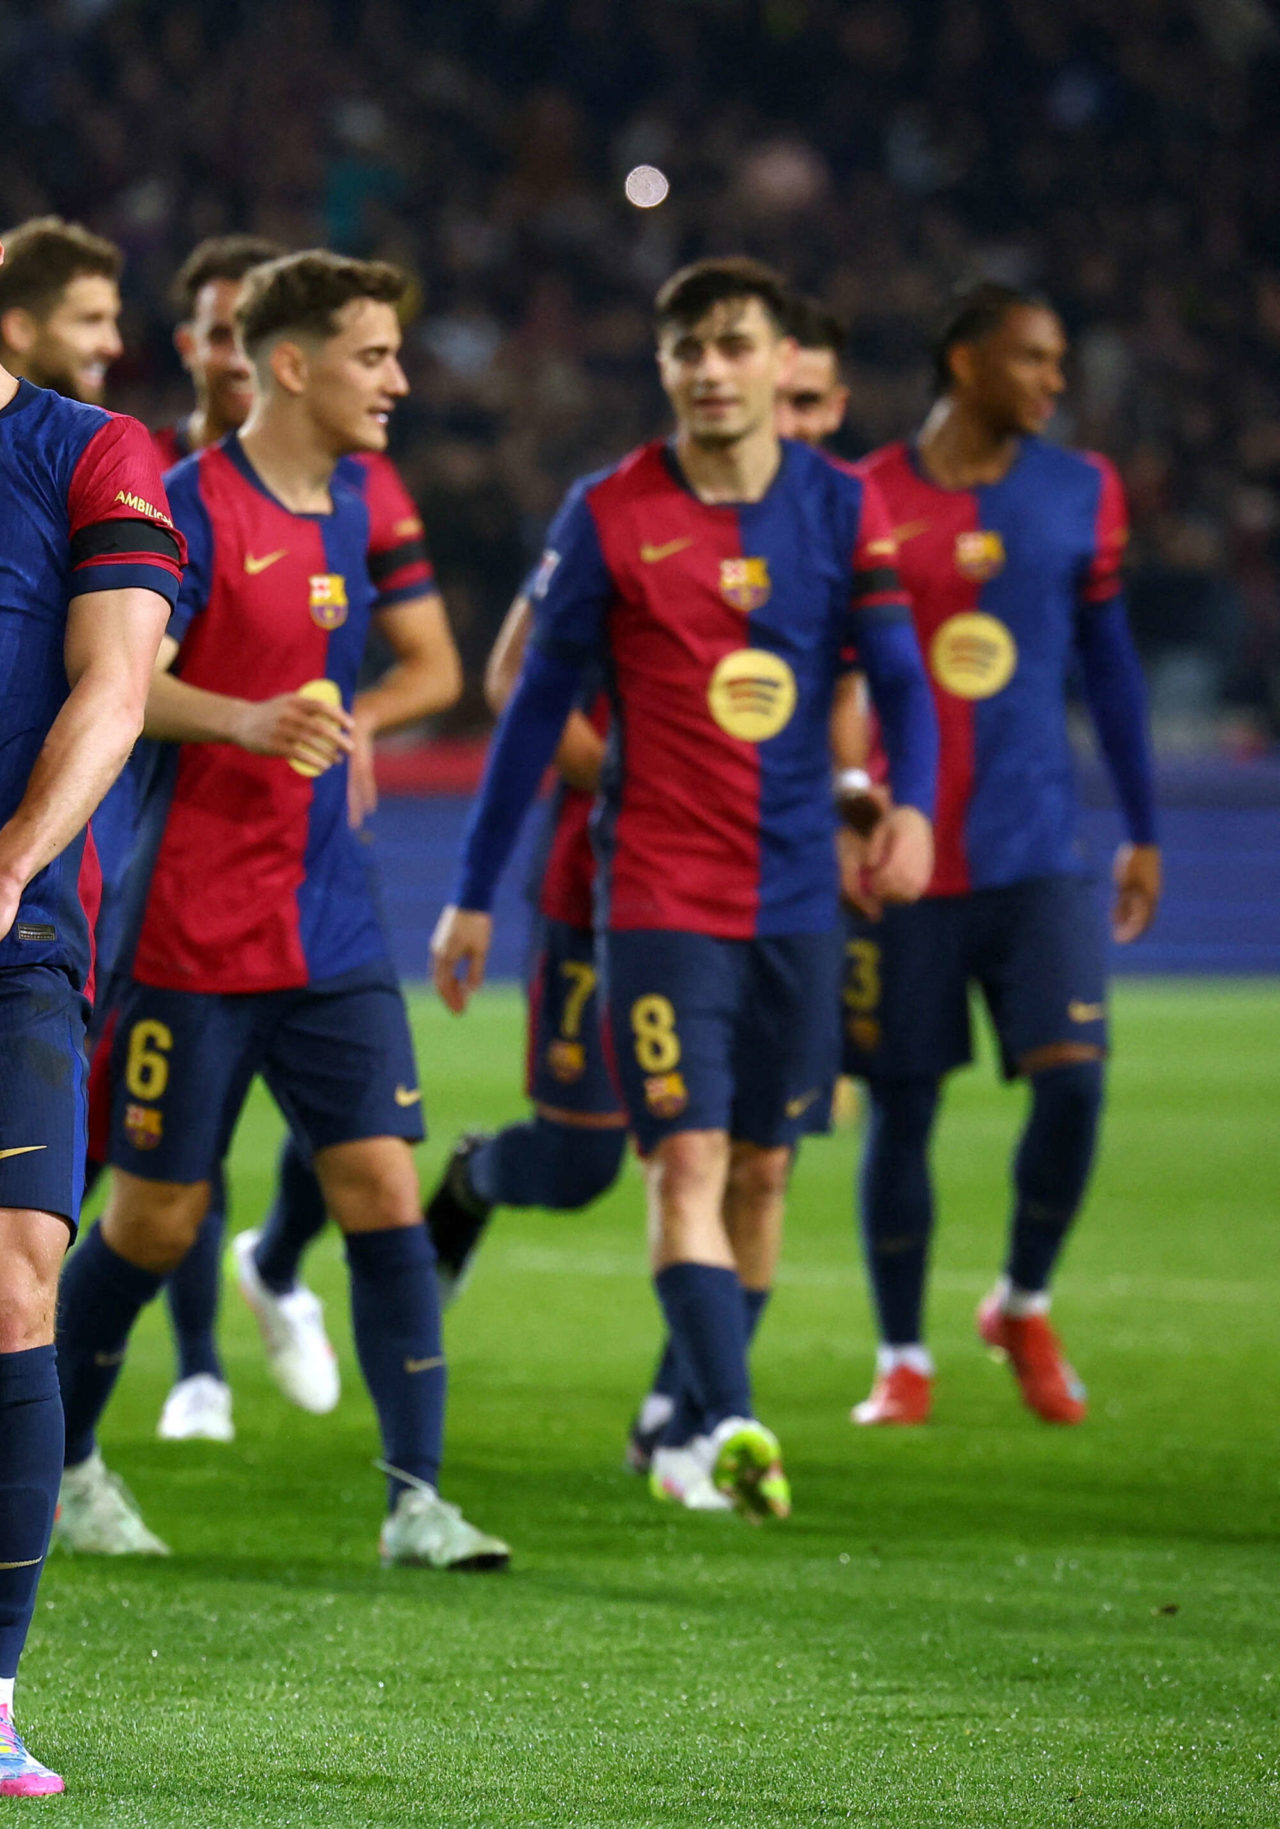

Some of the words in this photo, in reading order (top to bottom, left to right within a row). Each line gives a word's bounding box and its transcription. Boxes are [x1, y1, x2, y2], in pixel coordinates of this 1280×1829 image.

[562, 962, 596, 1037] 7
[844, 940, 880, 1010] 3
[126, 1019, 172, 1100] 6
[632, 994, 680, 1074] 8
